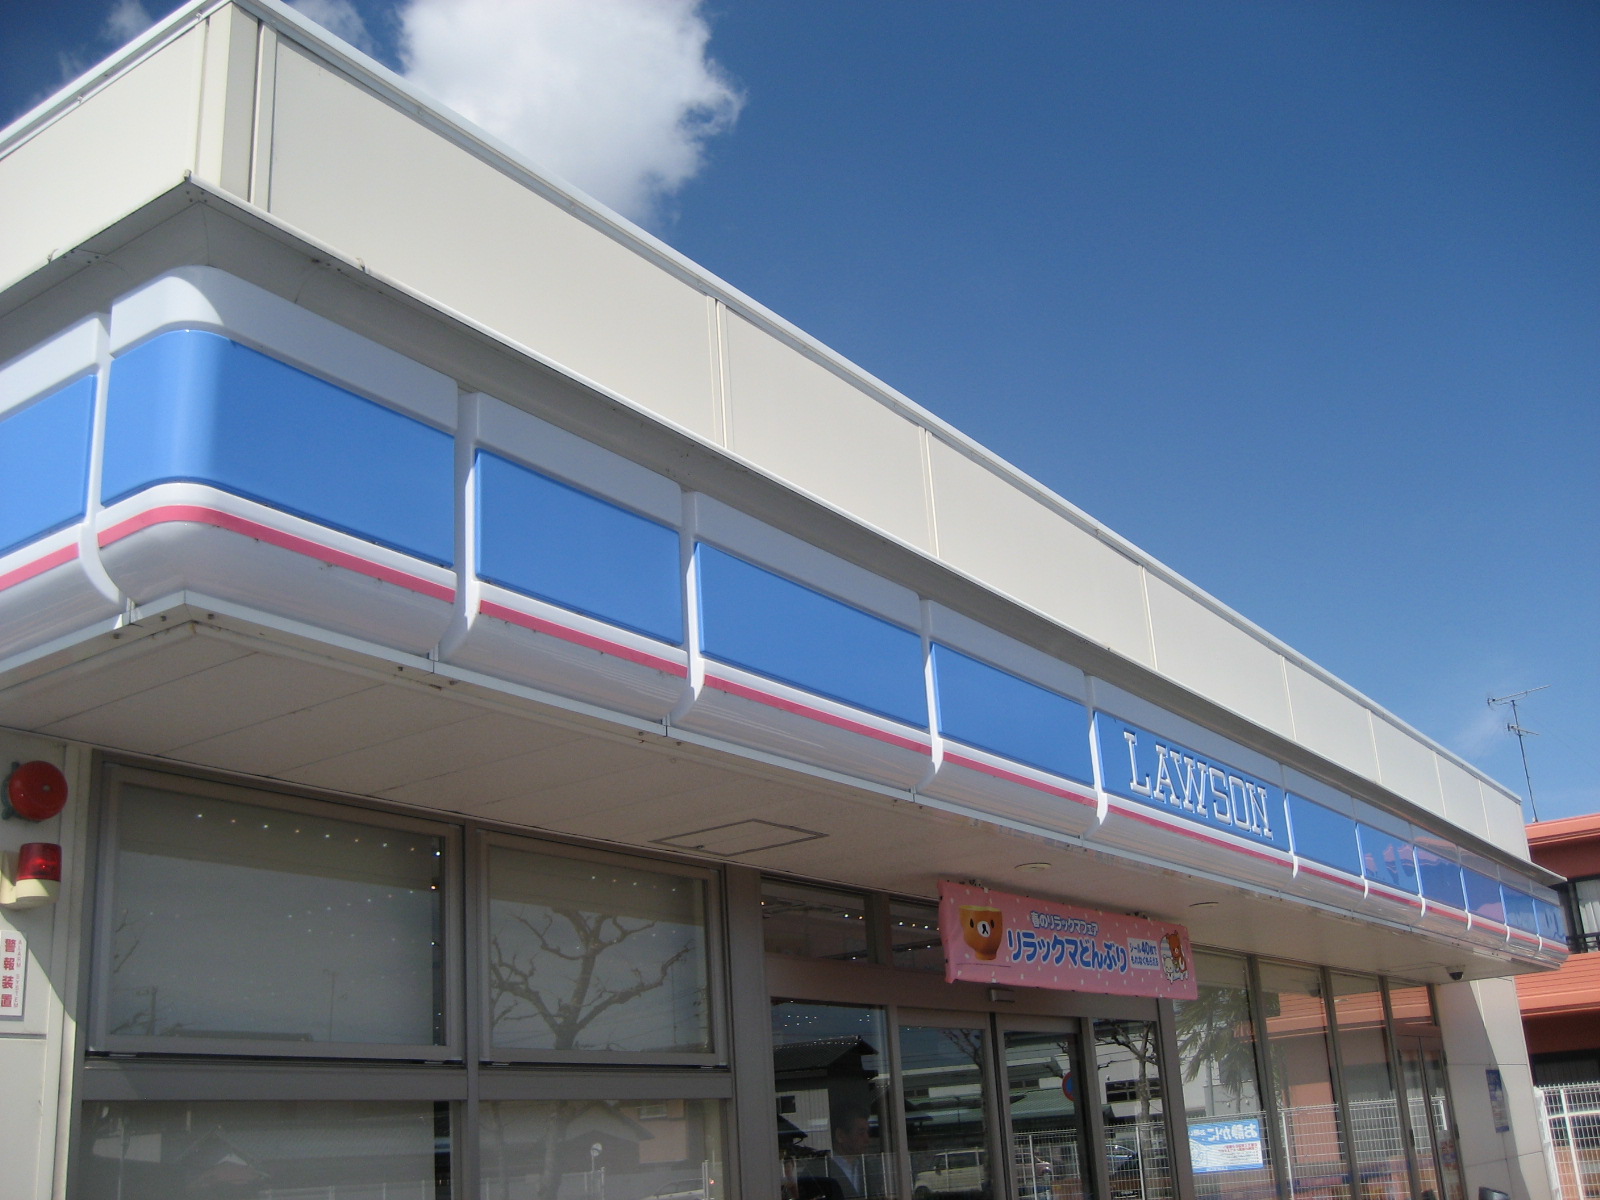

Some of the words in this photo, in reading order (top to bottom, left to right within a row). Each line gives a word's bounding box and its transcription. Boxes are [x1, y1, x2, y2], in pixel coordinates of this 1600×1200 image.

[1124, 730, 1273, 841] LAWSON
[1007, 929, 1128, 974] リラックマどんぶり
[1031, 911, 1098, 936] 春のリラックマフェア
[1, 939, 16, 1007] 警報装置
